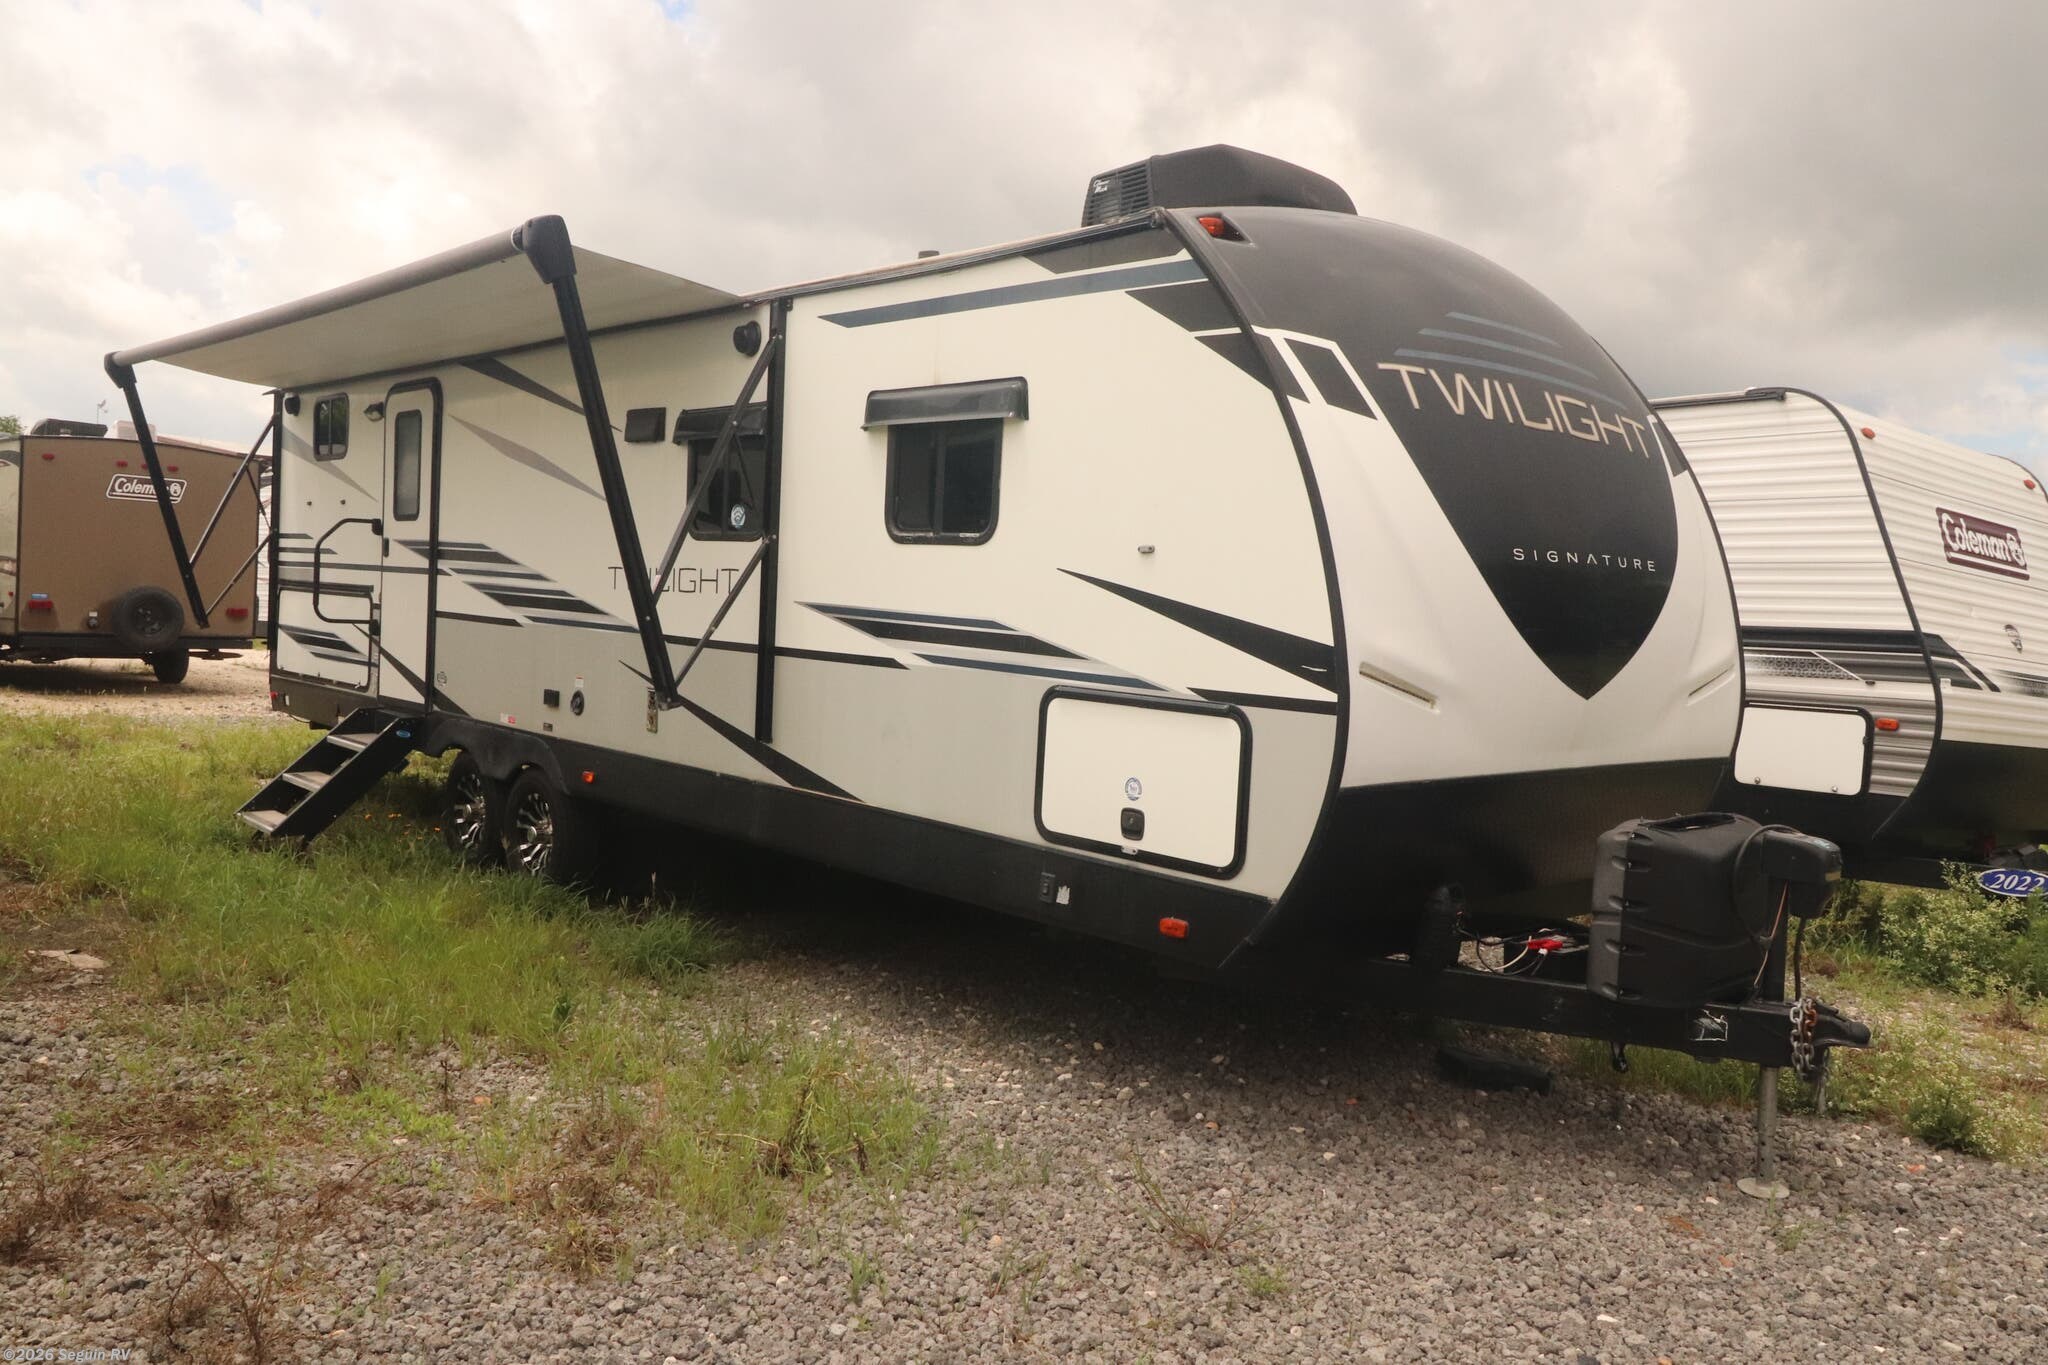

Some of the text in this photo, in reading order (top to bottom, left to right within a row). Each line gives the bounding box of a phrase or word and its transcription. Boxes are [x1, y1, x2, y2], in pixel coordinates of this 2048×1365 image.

[1377, 362, 1649, 459] TWILIGHT
[114, 477, 170, 495] Colem
[1941, 512, 2012, 562] Coleman
[1512, 548, 1656, 572] SIGNATURE
[607, 566, 740, 595] TILIGHT
[1989, 873, 2046, 892] 2022
